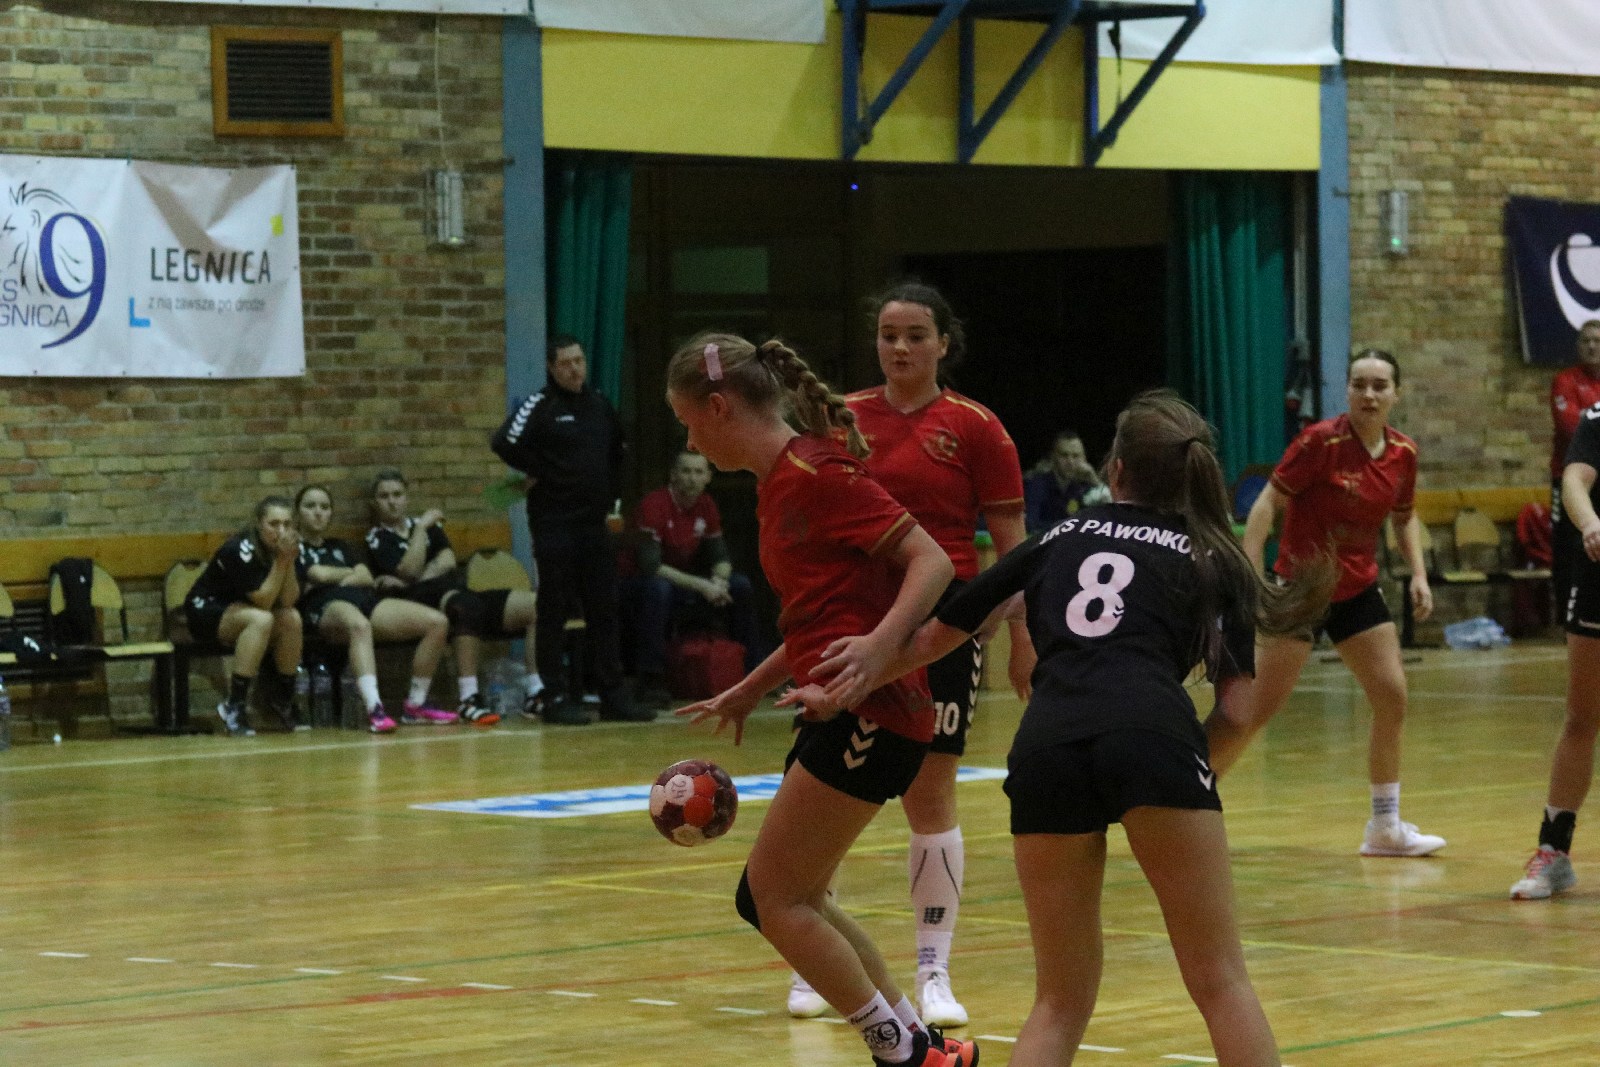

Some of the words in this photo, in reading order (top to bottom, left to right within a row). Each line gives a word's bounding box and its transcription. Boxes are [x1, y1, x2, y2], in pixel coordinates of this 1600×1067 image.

[39, 211, 107, 350] 9
[150, 247, 271, 284] LEGNICA
[1079, 519, 1212, 561] PAWONKO
[1065, 551, 1136, 638] 8
[933, 701, 961, 736] 10
